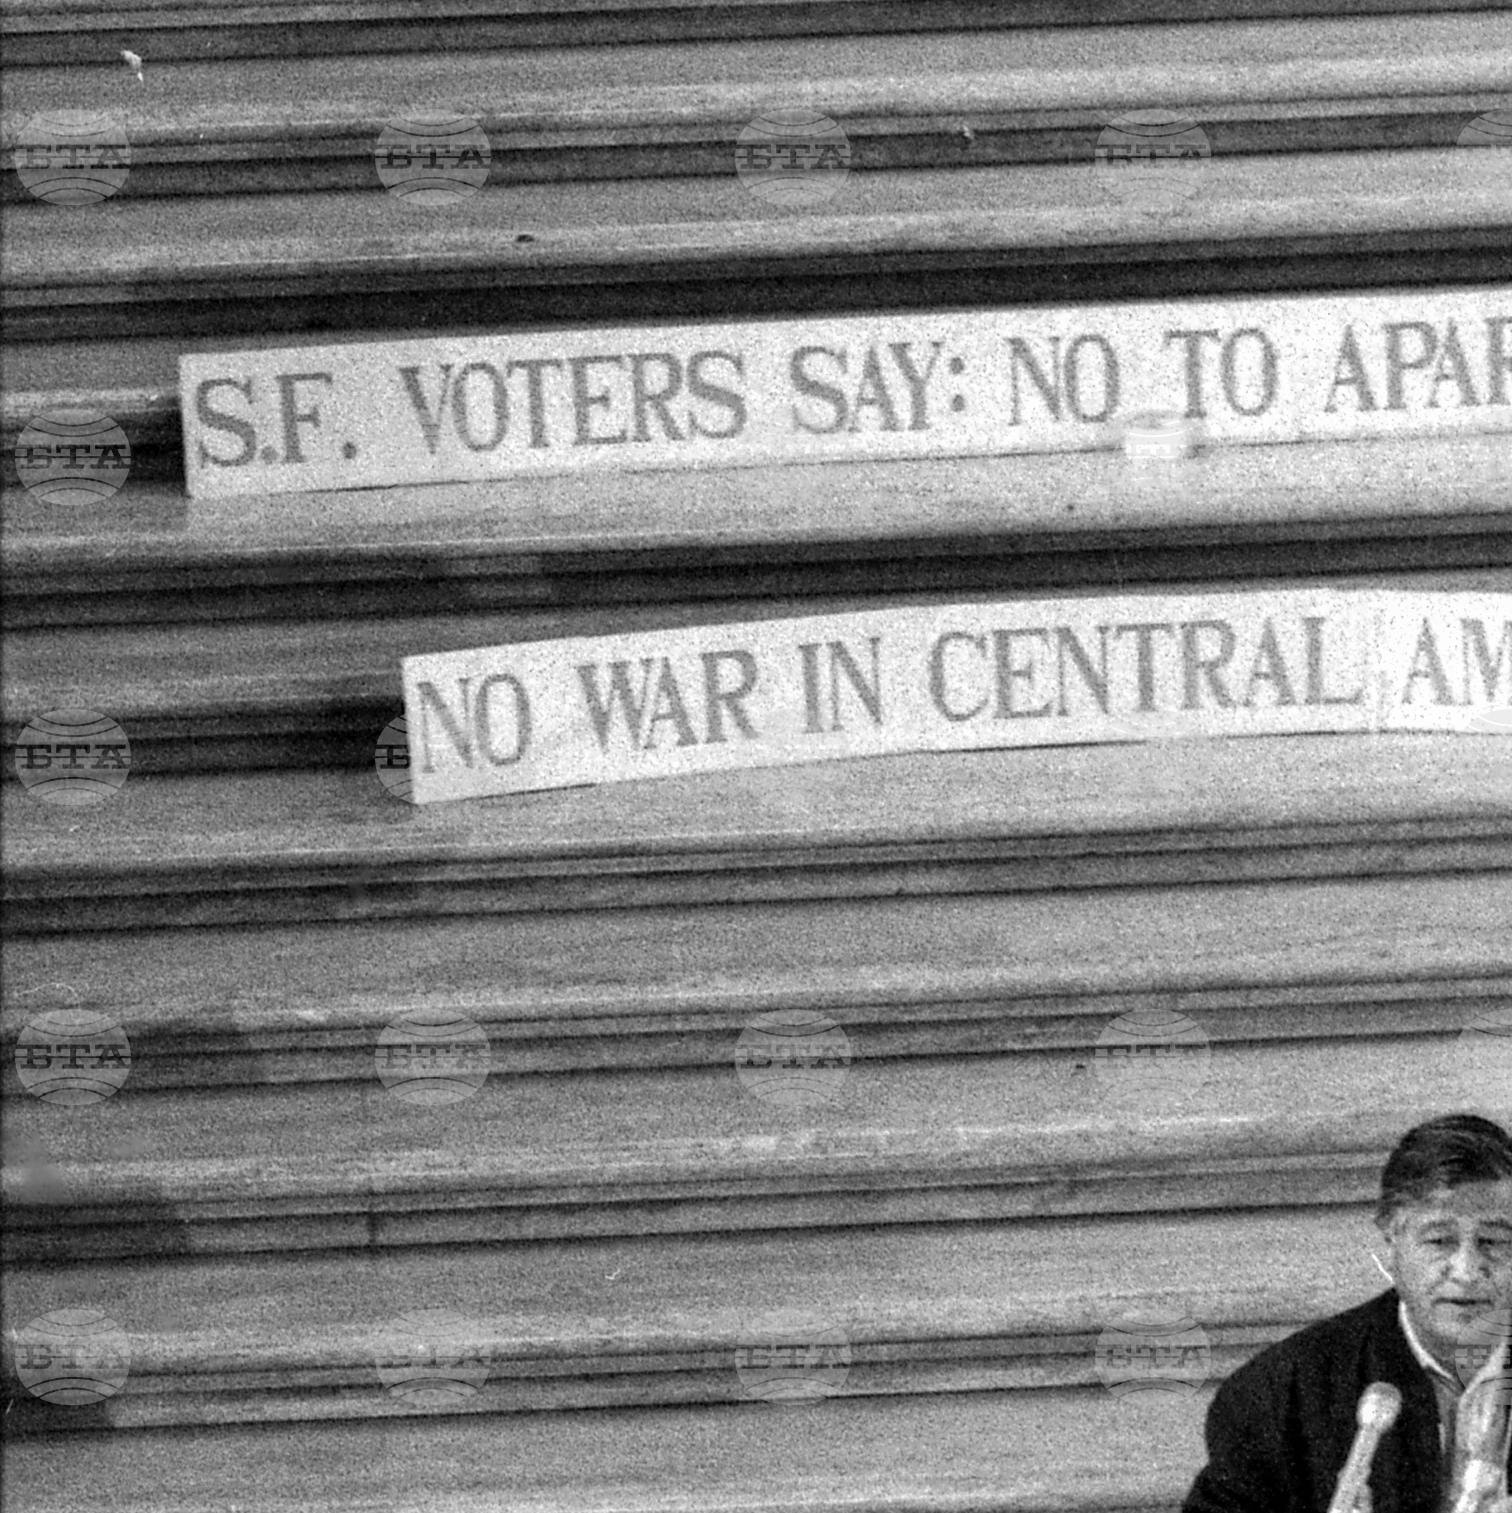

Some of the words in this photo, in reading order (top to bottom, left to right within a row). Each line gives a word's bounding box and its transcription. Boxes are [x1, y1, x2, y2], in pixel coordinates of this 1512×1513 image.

[196, 373, 356, 468] S.F.
[399, 349, 748, 454] VOTERS
[790, 340, 967, 436] SAY:
[1009, 334, 1120, 425] NO
[1165, 327, 1278, 418] TO
[415, 674, 532, 774] NO
[577, 650, 759, 750] WAR
[798, 636, 885, 734] IN
[928, 616, 1365, 722] CENTRAL
